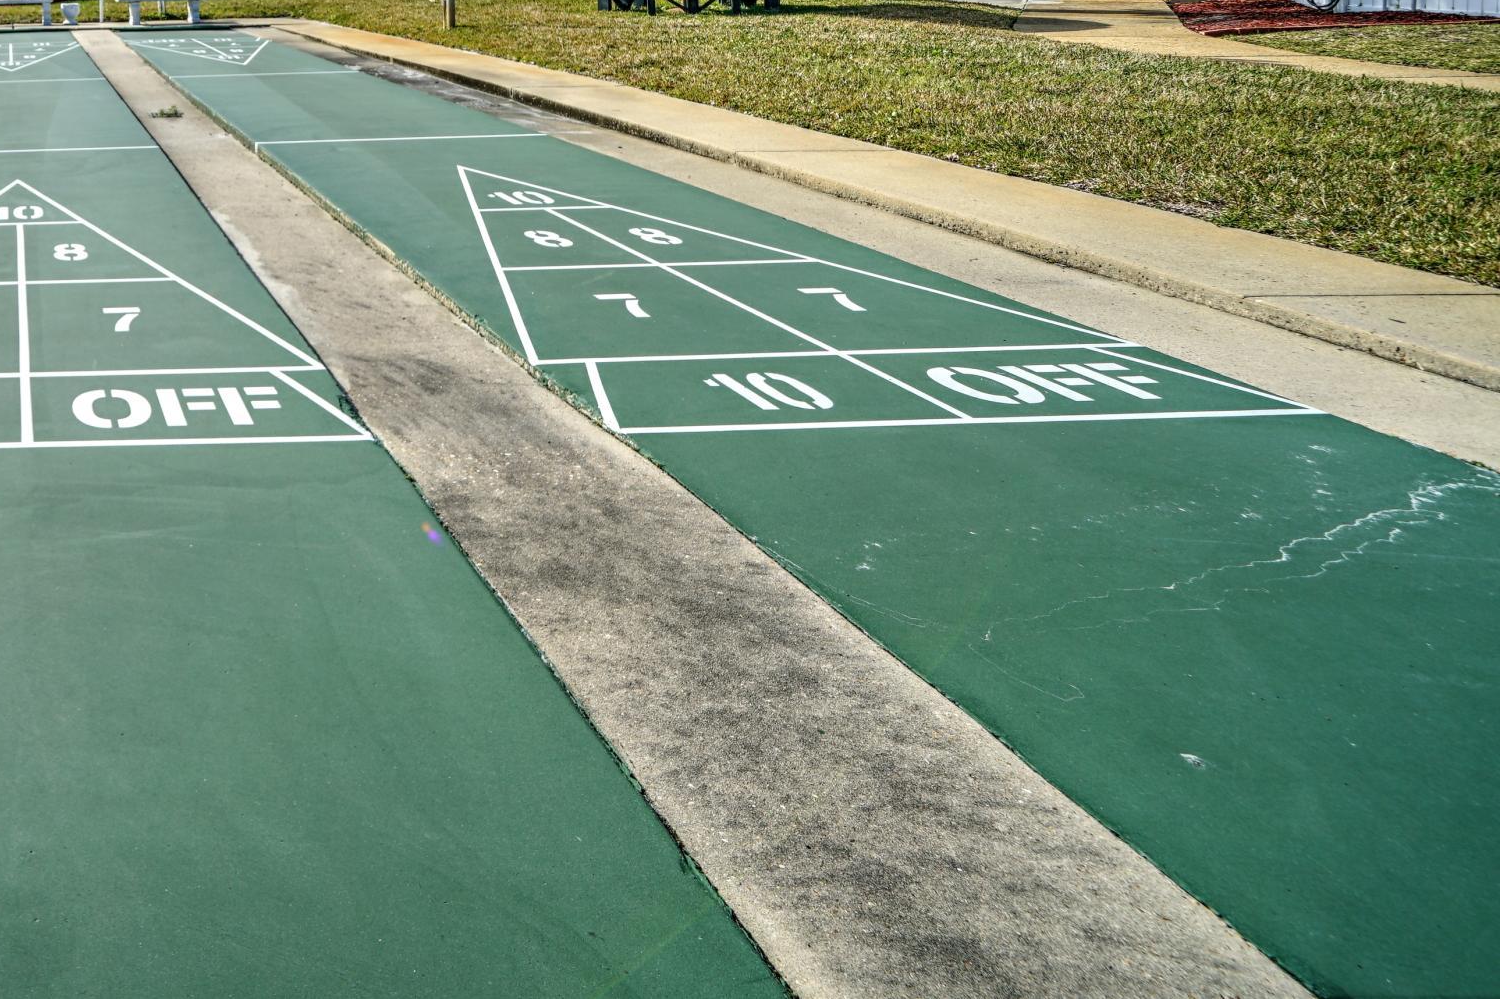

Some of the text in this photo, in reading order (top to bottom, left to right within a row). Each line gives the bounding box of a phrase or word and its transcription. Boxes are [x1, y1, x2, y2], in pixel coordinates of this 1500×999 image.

[488, 191, 555, 205] 10
[524, 230, 574, 248] 8
[628, 227, 683, 245] 8
[53, 243, 89, 262] 8
[594, 293, 651, 318] 7
[797, 287, 867, 312] 7
[102, 306, 141, 332] 7
[703, 364, 1162, 411] 10 OFF
[71, 386, 282, 429] OFF
